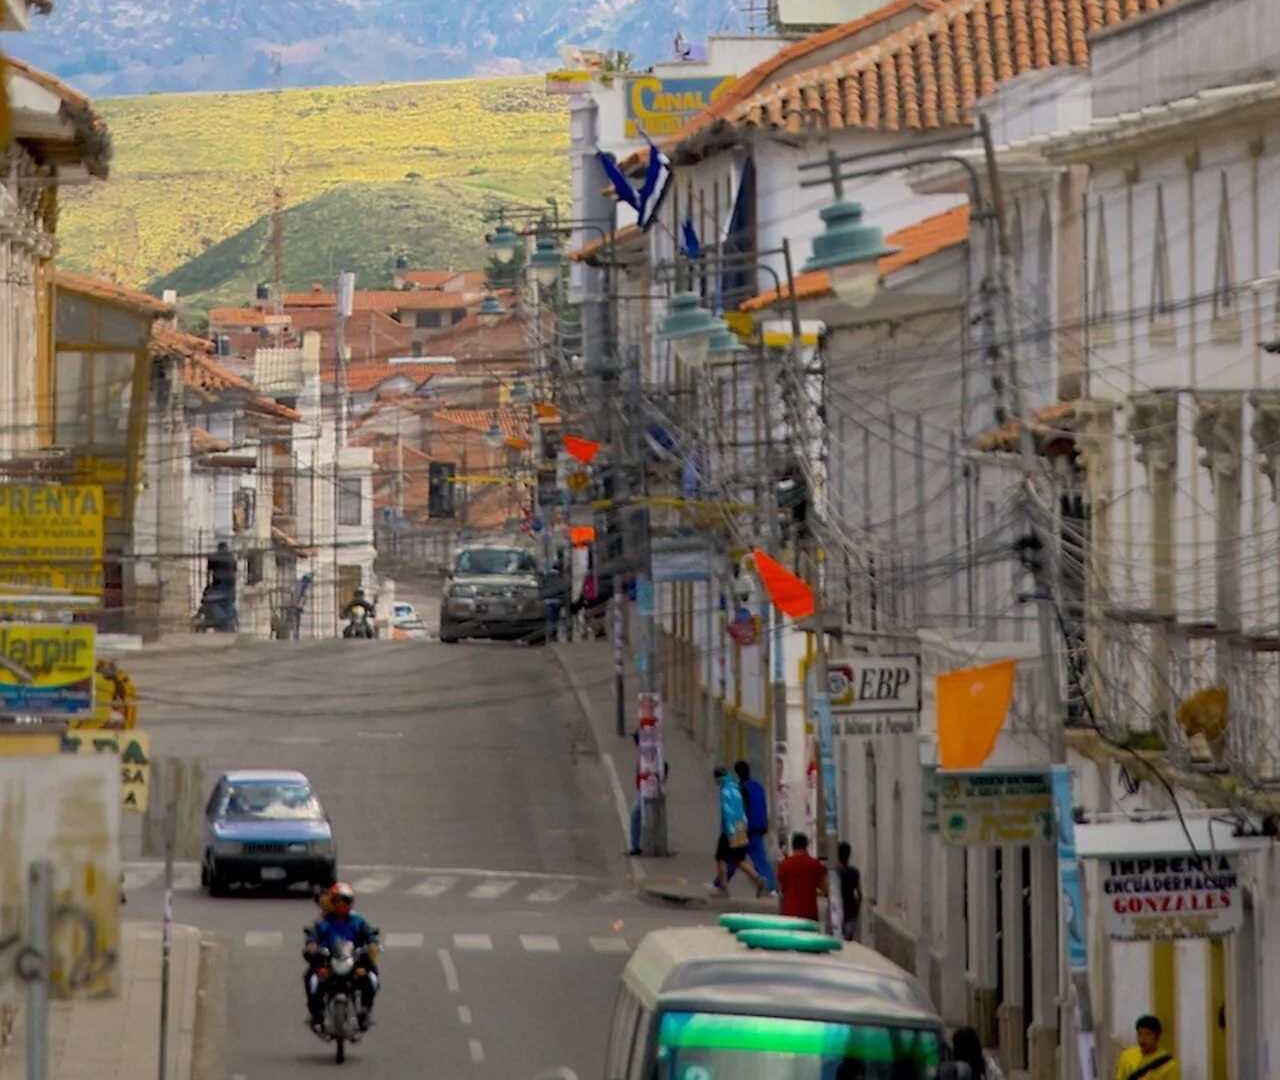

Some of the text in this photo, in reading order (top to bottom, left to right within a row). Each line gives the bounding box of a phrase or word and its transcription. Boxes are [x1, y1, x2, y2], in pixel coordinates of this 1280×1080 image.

[858, 667, 910, 701] EBP
[1109, 854, 1231, 876] IMPRENTA
[1113, 893, 1231, 914] GONZALES
